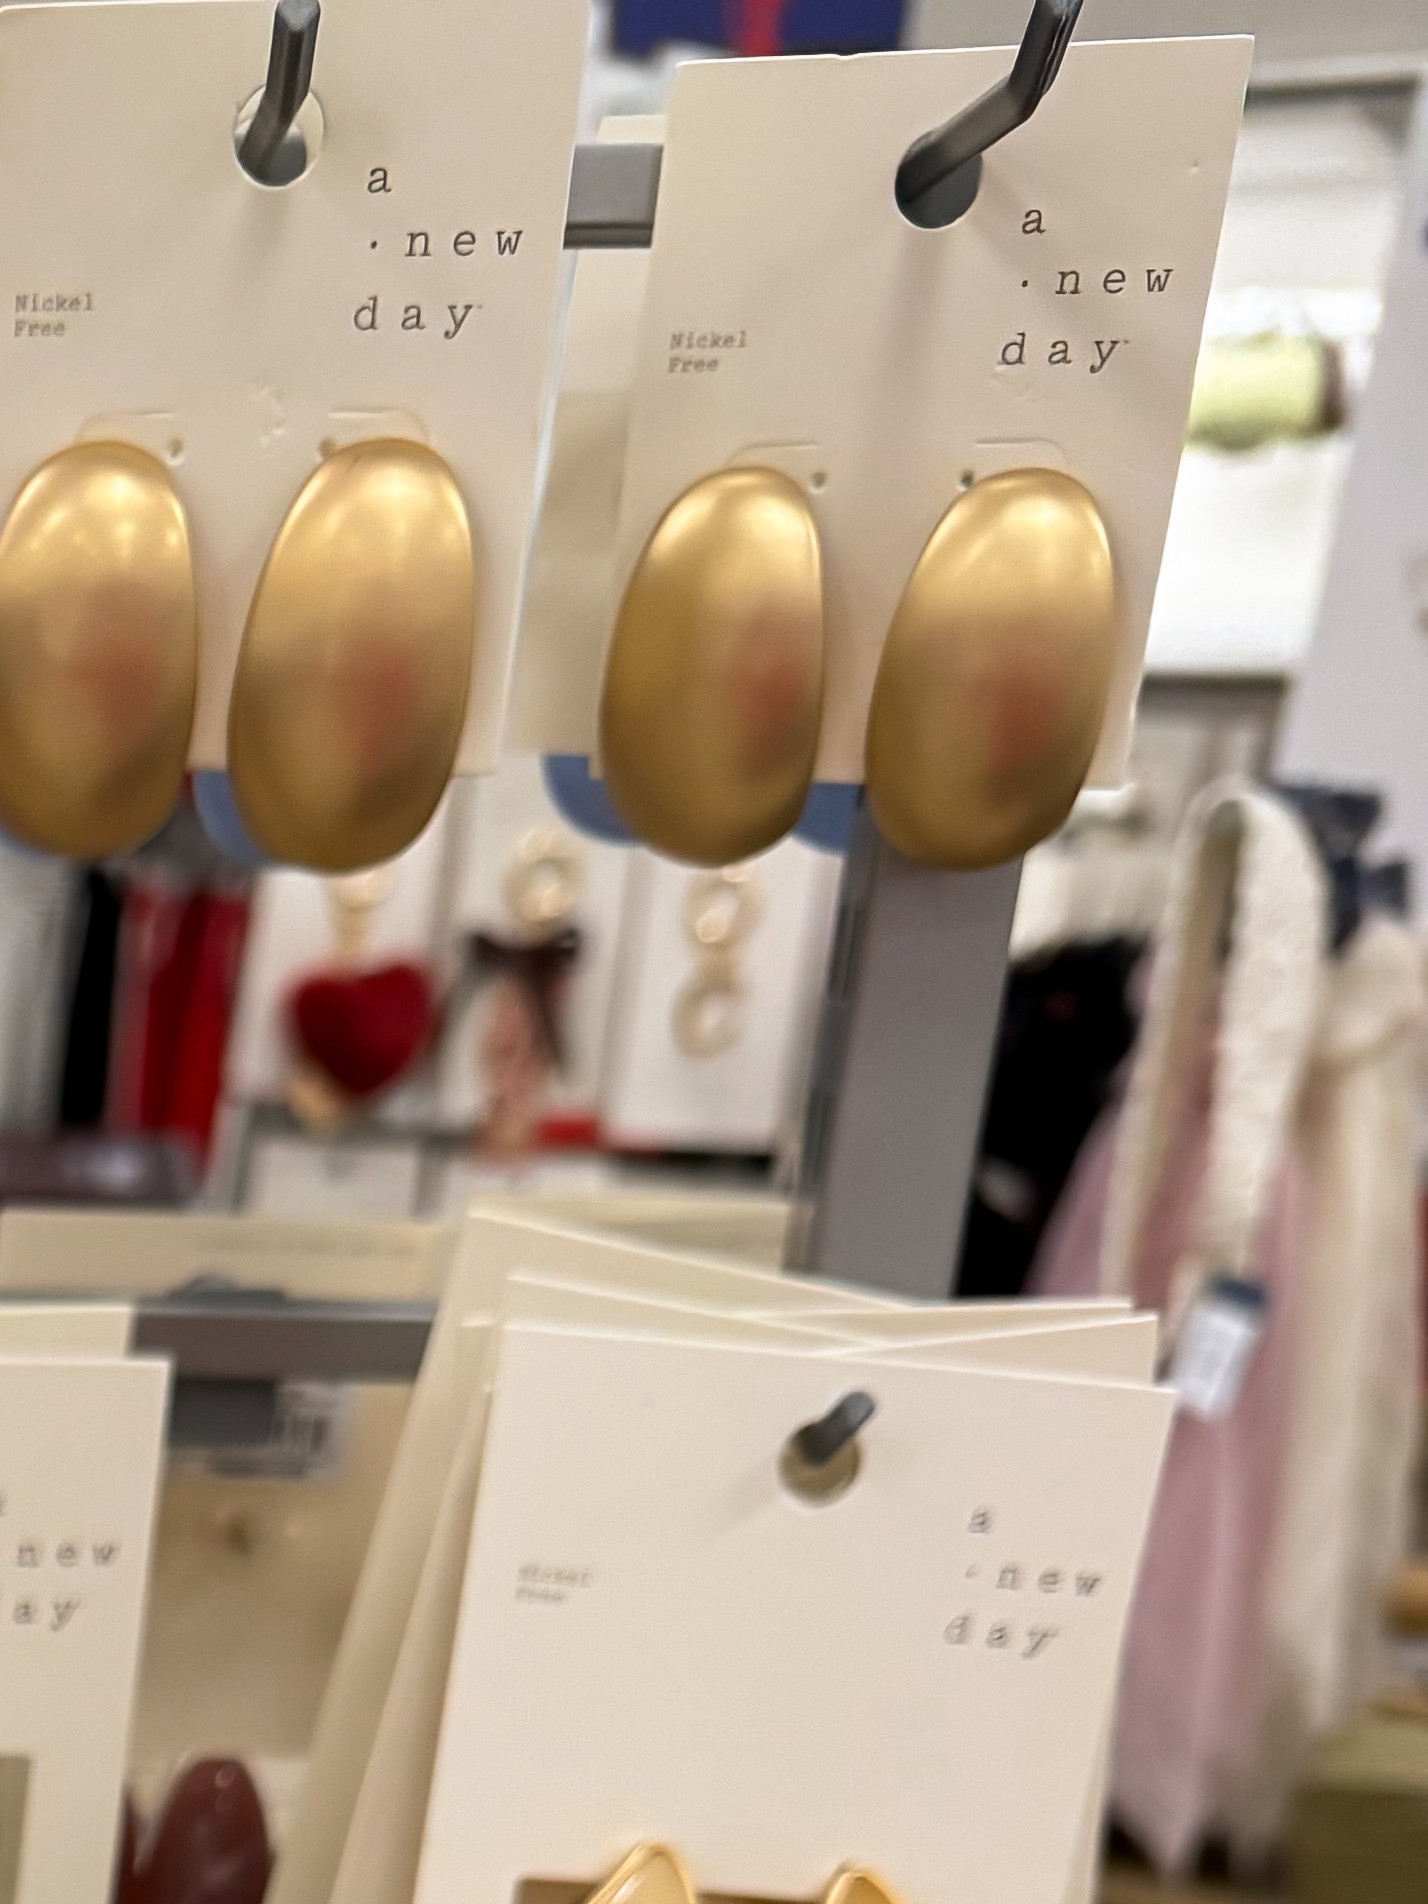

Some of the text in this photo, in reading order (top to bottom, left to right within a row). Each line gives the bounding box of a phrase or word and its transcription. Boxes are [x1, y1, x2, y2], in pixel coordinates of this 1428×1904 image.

[367, 165, 392, 195] a
[1021, 207, 1046, 236] a
[14, 293, 95, 313] Nickel
[13, 319, 66, 338] Free
[353, 295, 476, 339] day
[670, 331, 747, 351] Nickel
[667, 356, 719, 374] Free
[1000, 333, 1123, 375] day
